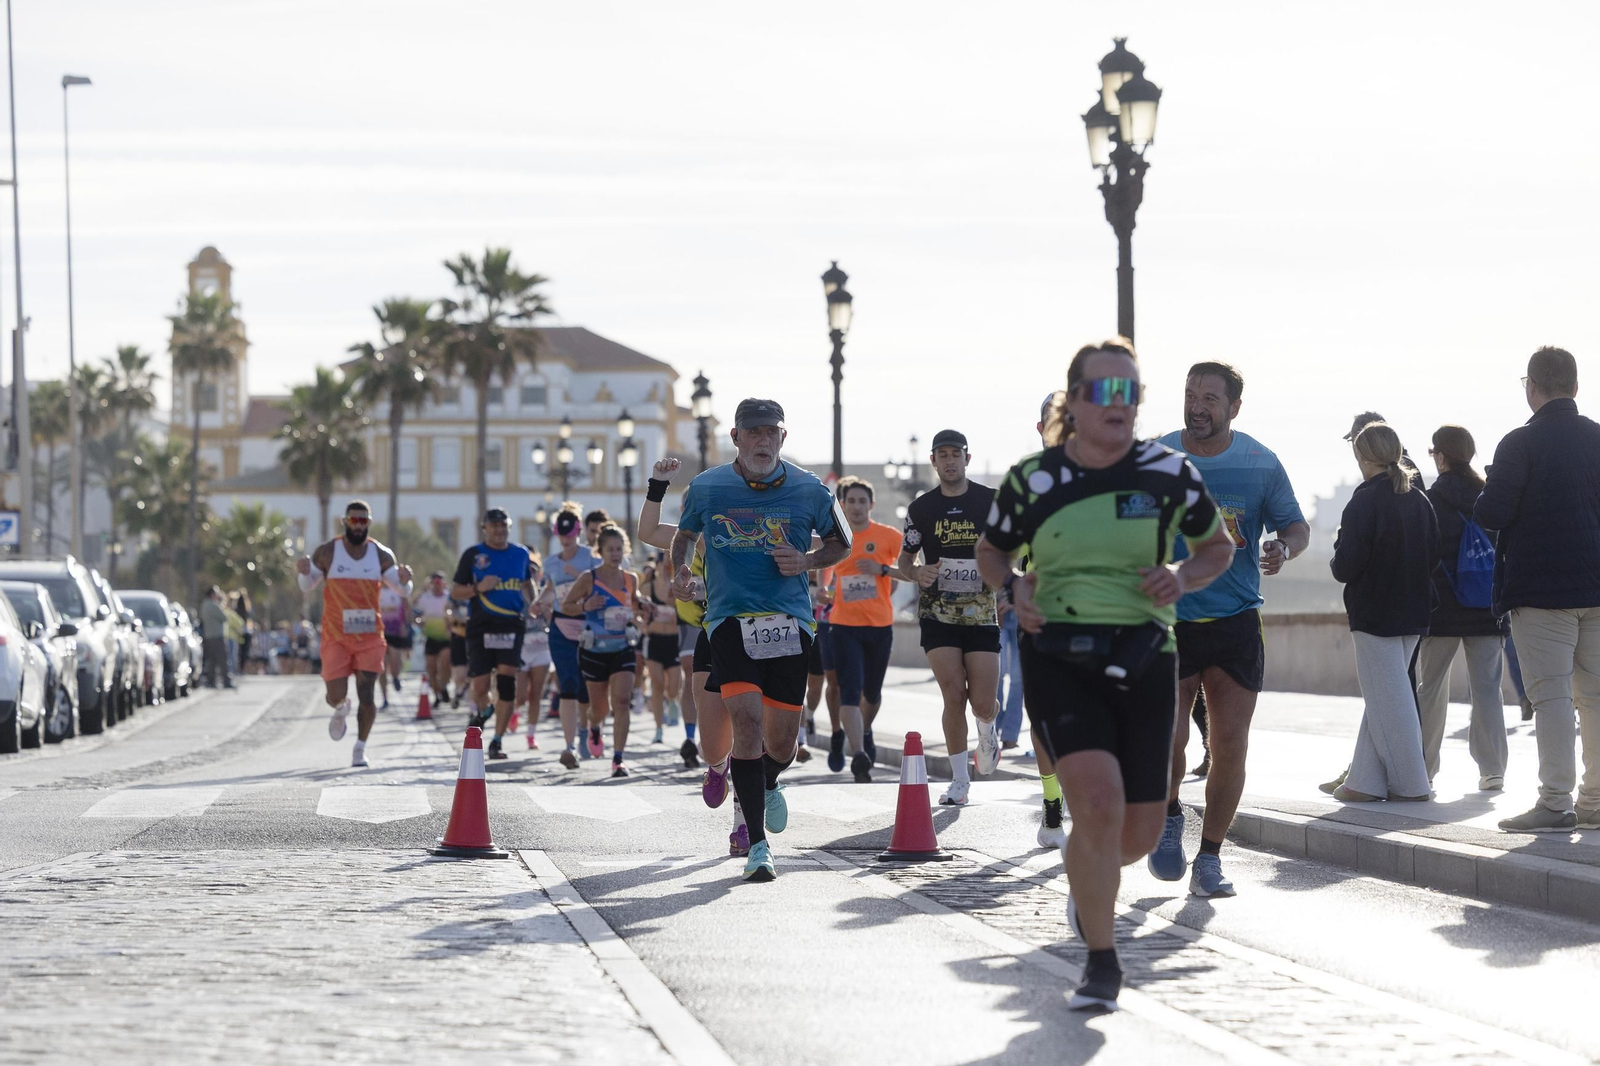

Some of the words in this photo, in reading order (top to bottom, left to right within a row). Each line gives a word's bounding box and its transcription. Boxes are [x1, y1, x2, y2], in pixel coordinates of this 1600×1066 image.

[944, 568, 978, 582] 2120
[848, 581, 868, 593] 547
[750, 625, 791, 645] 1337
